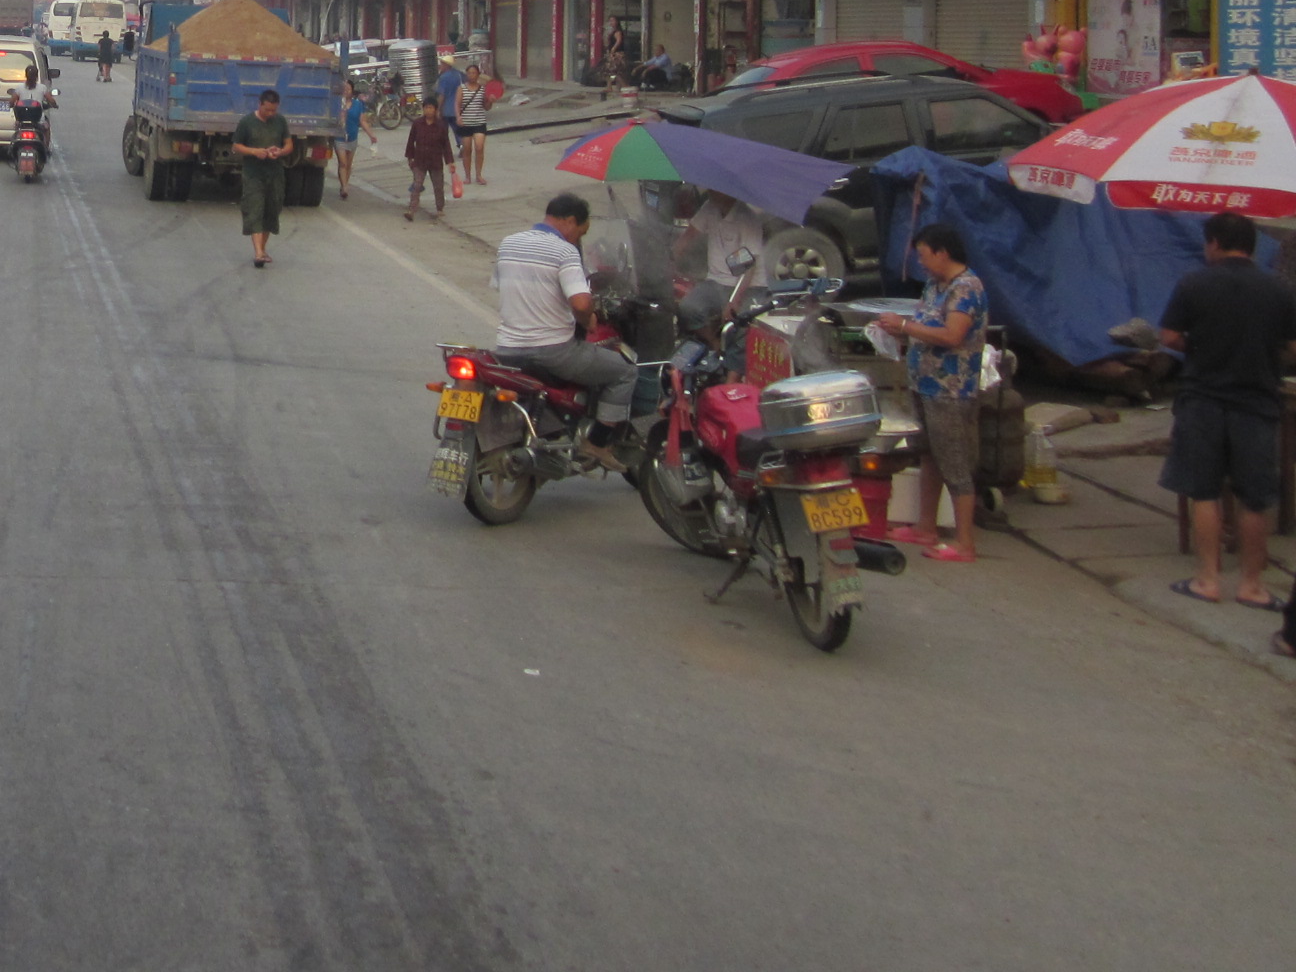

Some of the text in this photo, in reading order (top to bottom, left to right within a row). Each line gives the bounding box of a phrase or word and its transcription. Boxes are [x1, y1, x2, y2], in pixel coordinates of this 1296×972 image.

[1170, 146, 1258, 160] 燕京啤酒
[1151, 183, 1252, 209] 敢为天下鲜
[810, 506, 863, 529] BC599
